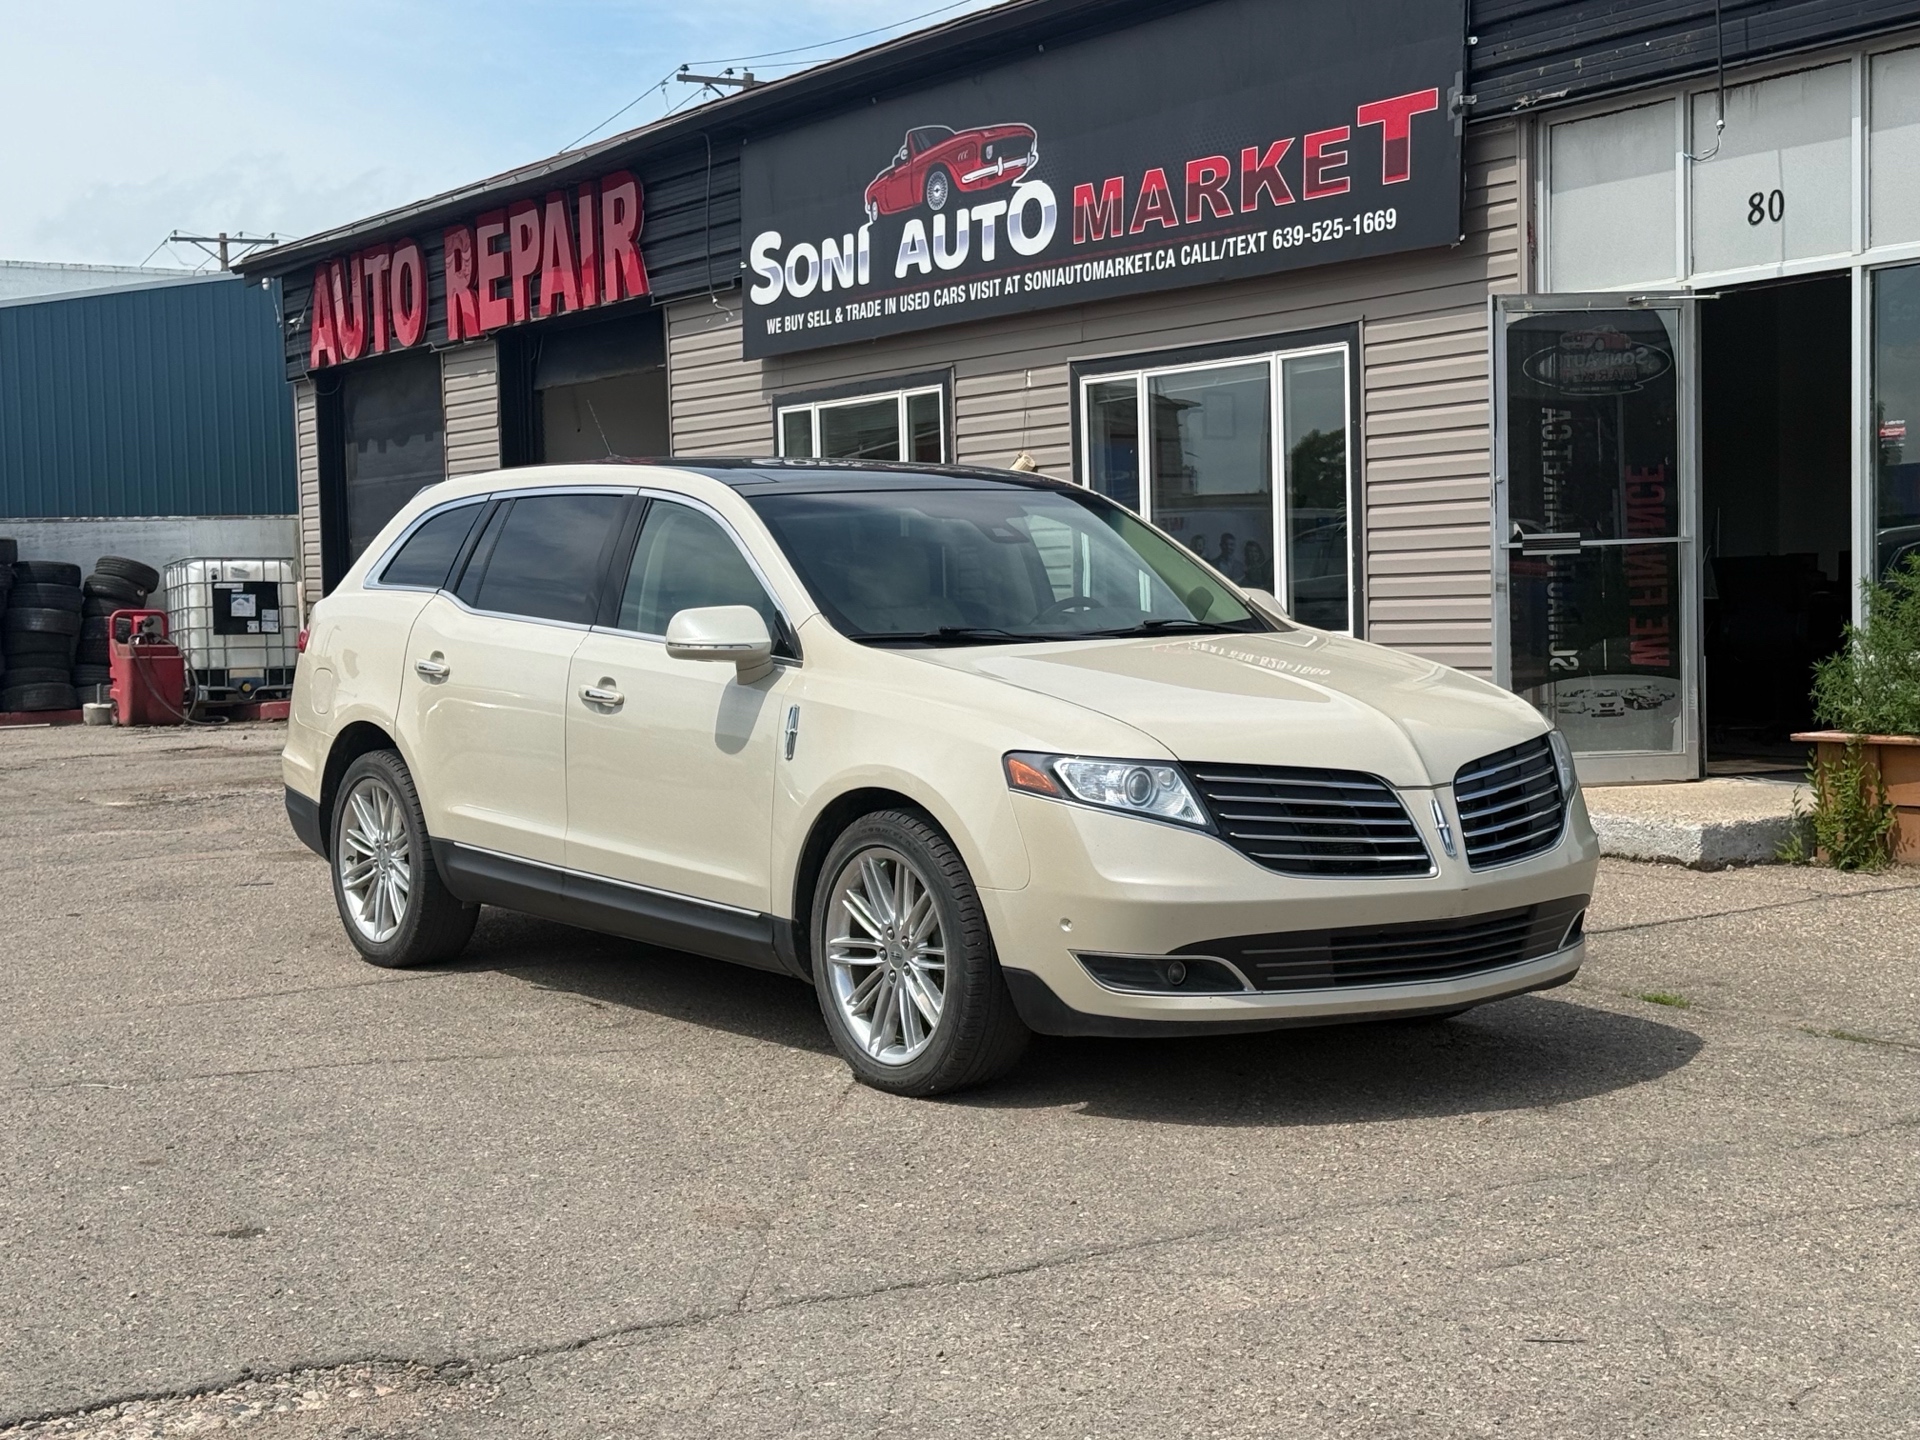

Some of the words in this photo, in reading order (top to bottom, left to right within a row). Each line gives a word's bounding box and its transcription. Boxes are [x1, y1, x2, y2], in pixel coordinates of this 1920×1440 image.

[310, 236, 428, 369] AUTO
[444, 170, 650, 342] REPAIR
[750, 224, 872, 305] SONI
[895, 180, 1057, 279] AUTO
[1073, 87, 1439, 245] MARKET
[766, 318, 782, 335] WE
[784, 313, 805, 332] BUY
[807, 309, 832, 329] SELL
[835, 307, 844, 324] &
[845, 300, 882, 322] TRADE
[885, 296, 897, 316] IN
[899, 291, 930, 313] USED
[933, 285, 966, 308] CARS
[969, 278, 1001, 301] VISIT
[1004, 275, 1021, 296] AT
[1024, 245, 1176, 292] SONIAUTOMARKET.CA
[1180, 230, 1268, 267] CALL/TEXT
[1272, 207, 1397, 250] 639-525-1669
[1747, 188, 1785, 226] 80
